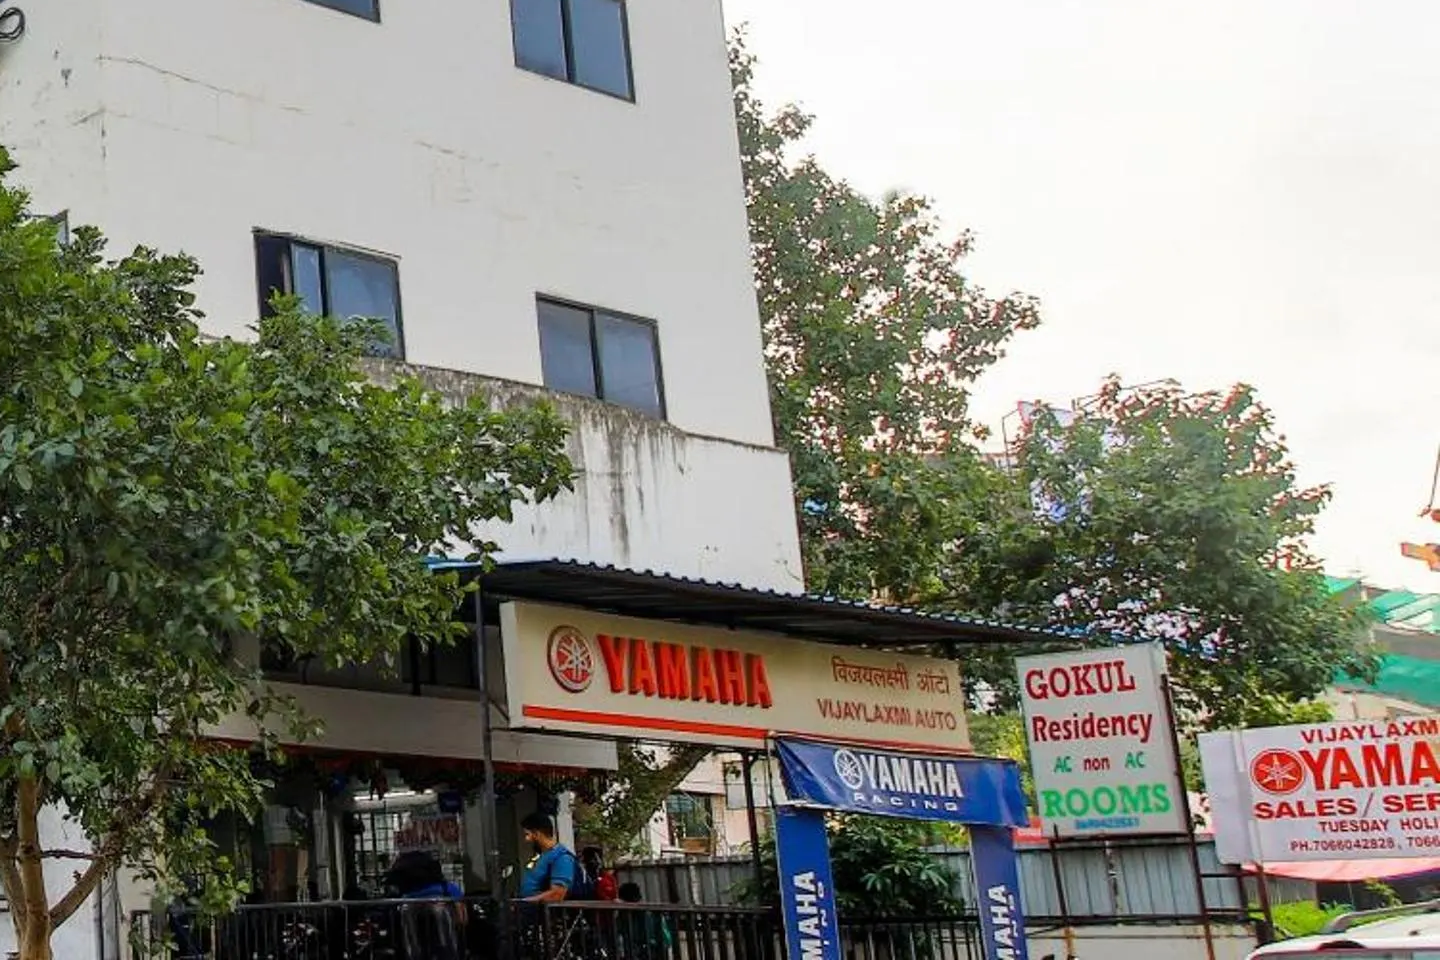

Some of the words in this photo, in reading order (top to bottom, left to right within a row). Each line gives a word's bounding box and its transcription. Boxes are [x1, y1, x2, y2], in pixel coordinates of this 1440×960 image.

[596, 633, 773, 709] YAMAHA
[1025, 659, 1137, 700] GOKUL
[817, 698, 909, 727] VIJAYLAXMI
[914, 708, 958, 731] AUTO
[1032, 712, 1153, 743] Residency
[860, 753, 964, 798] YAMAHA
[1053, 756, 1073, 773] AC
[1083, 757, 1110, 771] non
[1125, 751, 1146, 769] AC
[1298, 740, 1440, 791] YAMA
[853, 792, 959, 812] RACING
[1041, 783, 1172, 818] ROOMS
[1254, 797, 1358, 820] SALES
[1318, 819, 1390, 833] TUESDAY
